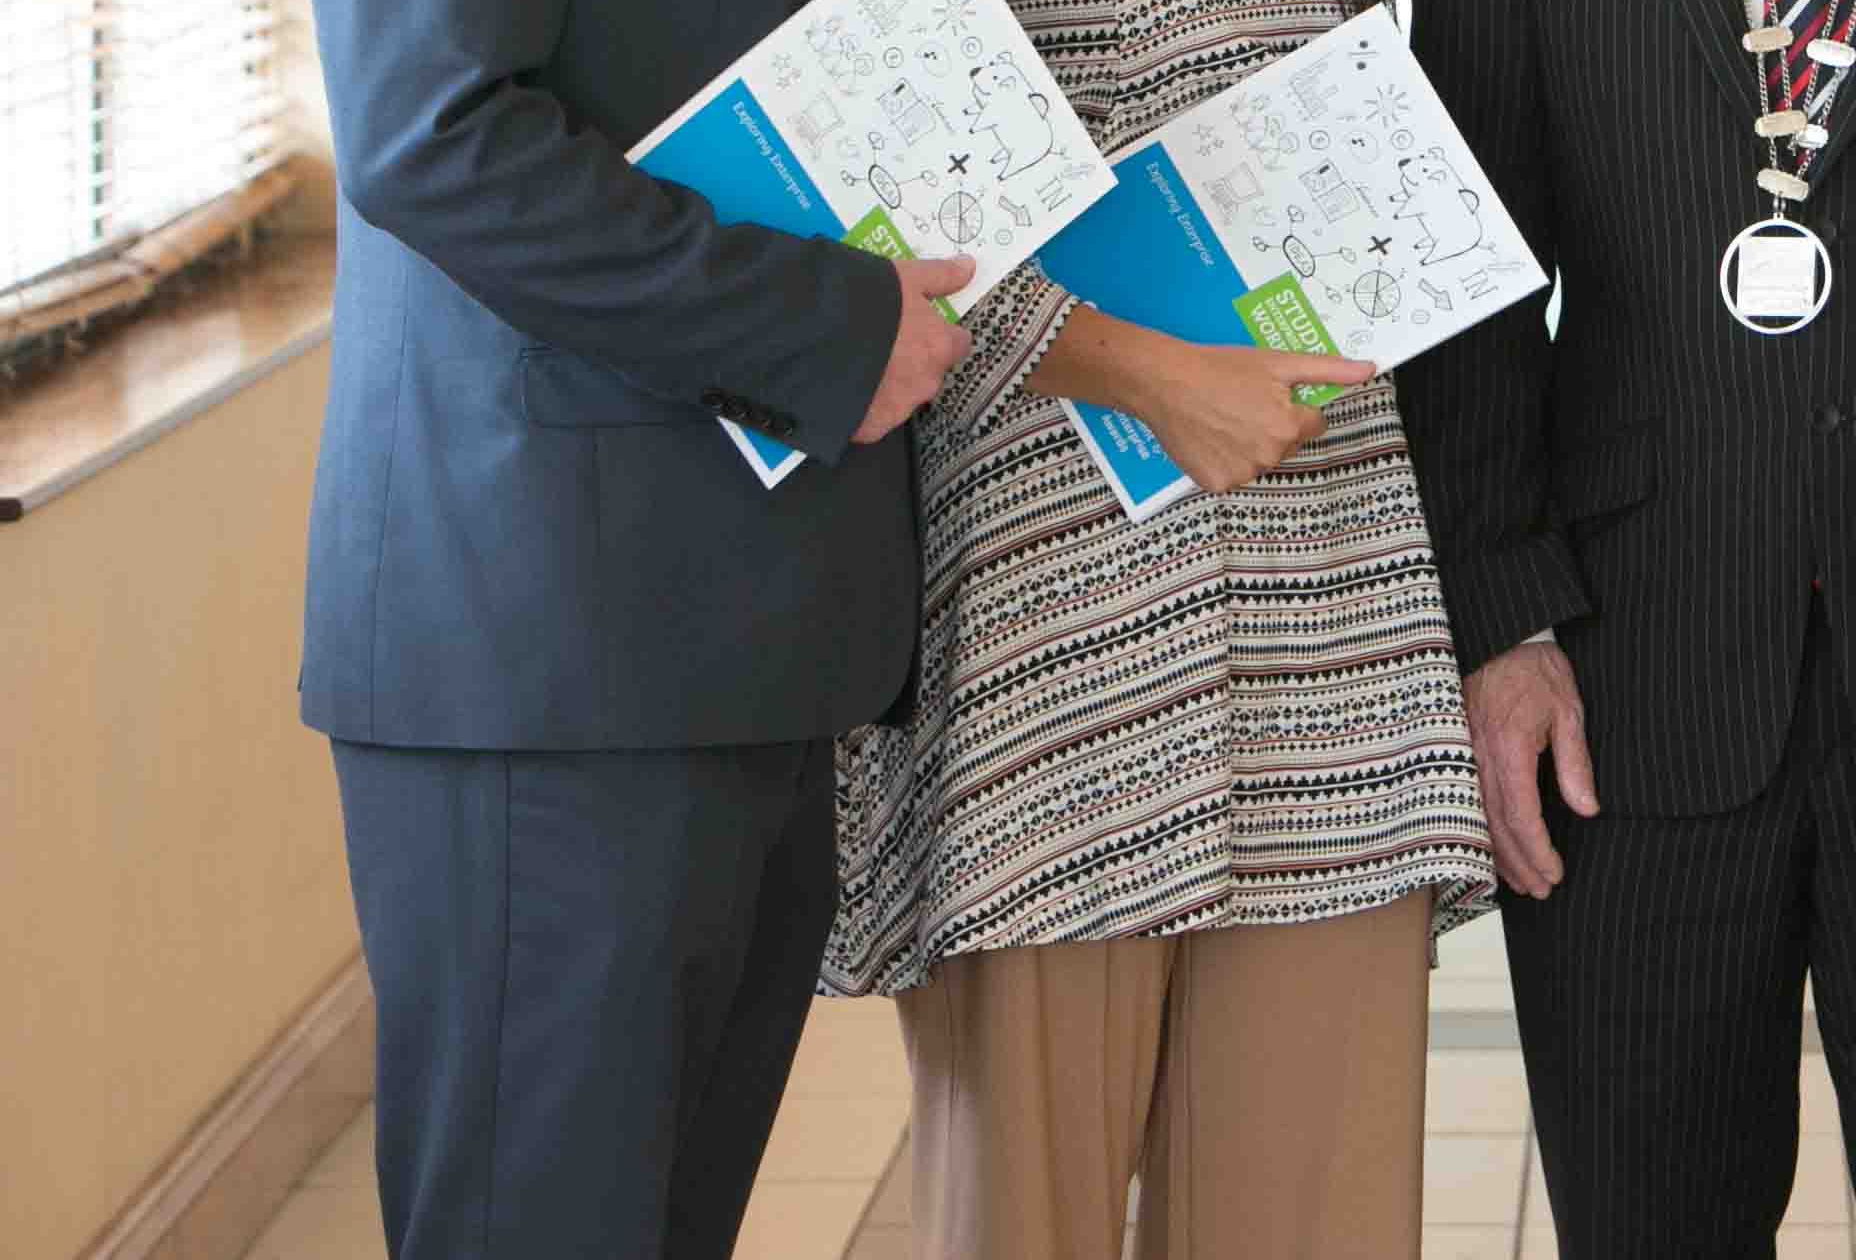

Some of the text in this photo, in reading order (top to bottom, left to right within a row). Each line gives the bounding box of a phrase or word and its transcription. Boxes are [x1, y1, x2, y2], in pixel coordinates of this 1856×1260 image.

[733, 101, 772, 157] Exploring
[1145, 161, 1182, 214] Exploring
[1275, 289, 1328, 355] STUDE
